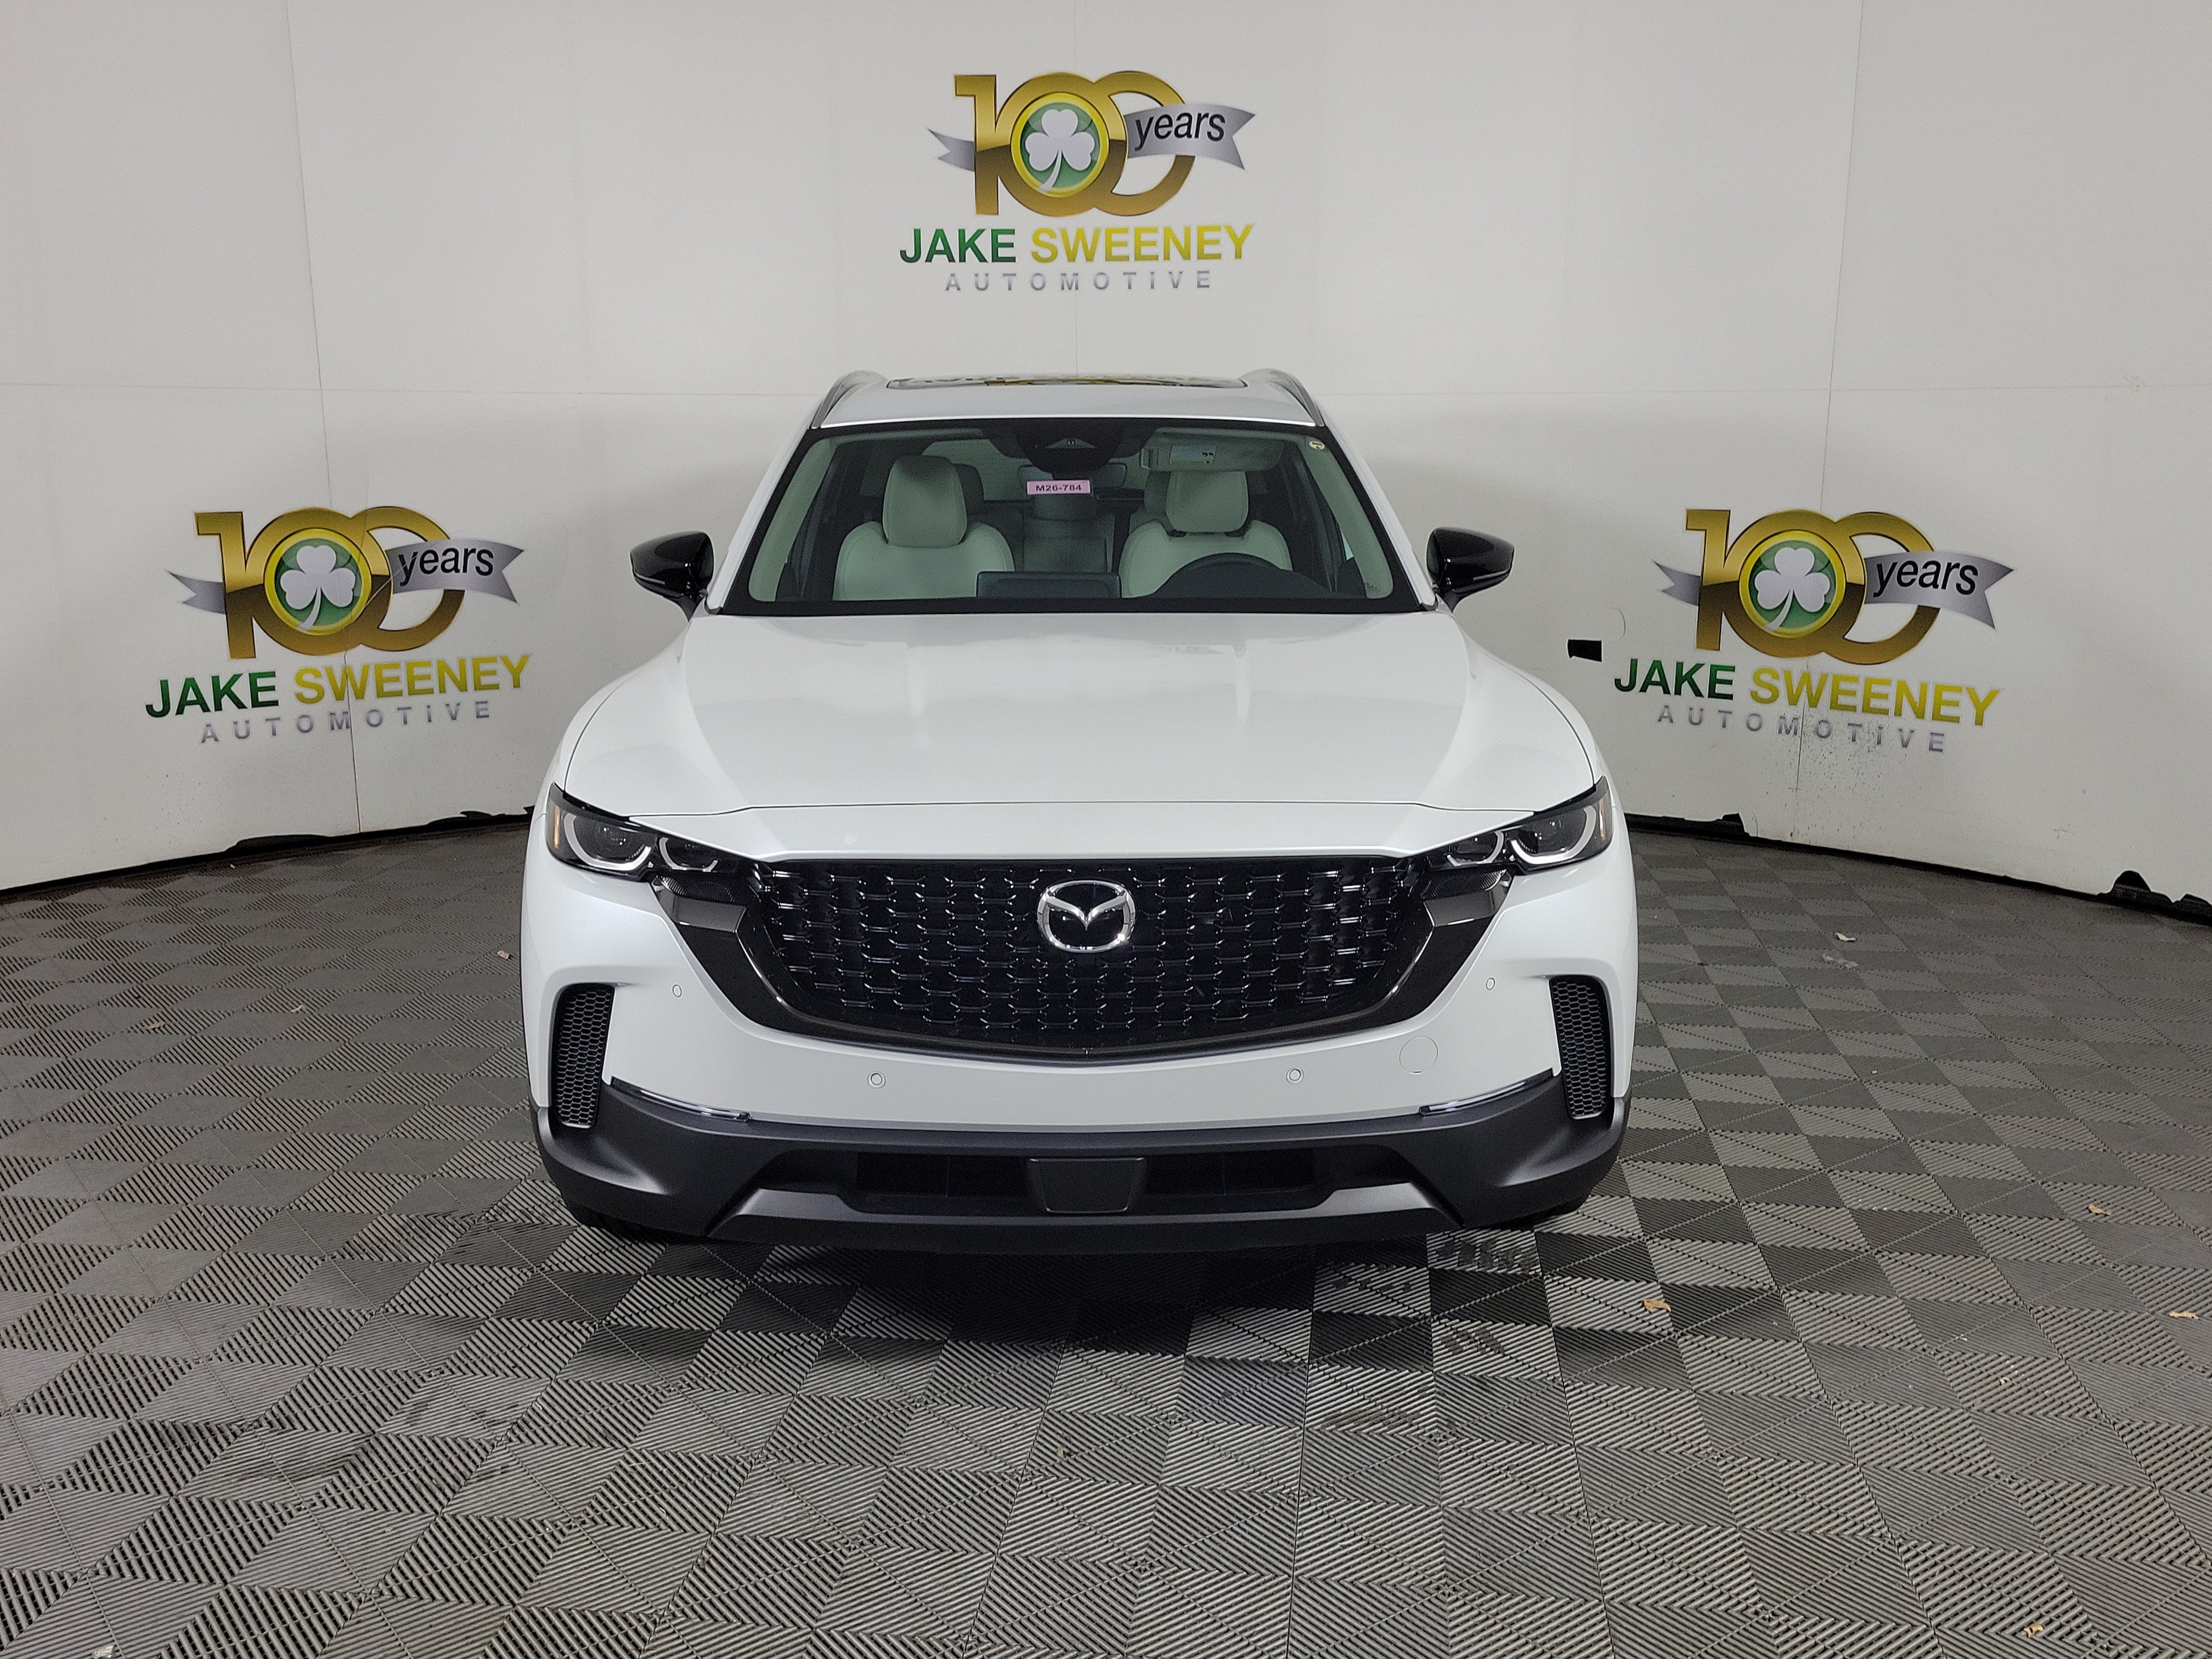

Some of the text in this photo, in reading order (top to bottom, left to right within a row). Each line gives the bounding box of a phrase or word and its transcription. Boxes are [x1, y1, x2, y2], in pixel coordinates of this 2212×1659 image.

[953, 70, 1226, 217] 100 years
[900, 224, 1254, 263] JAKE SWEENEY
[945, 270, 1210, 291] AUTOMOTIVE
[194, 506, 494, 659] 100 years
[1685, 509, 1979, 665] 100 years
[145, 654, 530, 718] JAKE SWEENEY
[1614, 658, 2000, 726] JAKE SWEENEY
[200, 701, 490, 744] AUTOMOTIVE
[1657, 705, 1945, 753] AUTOMOTIVE
